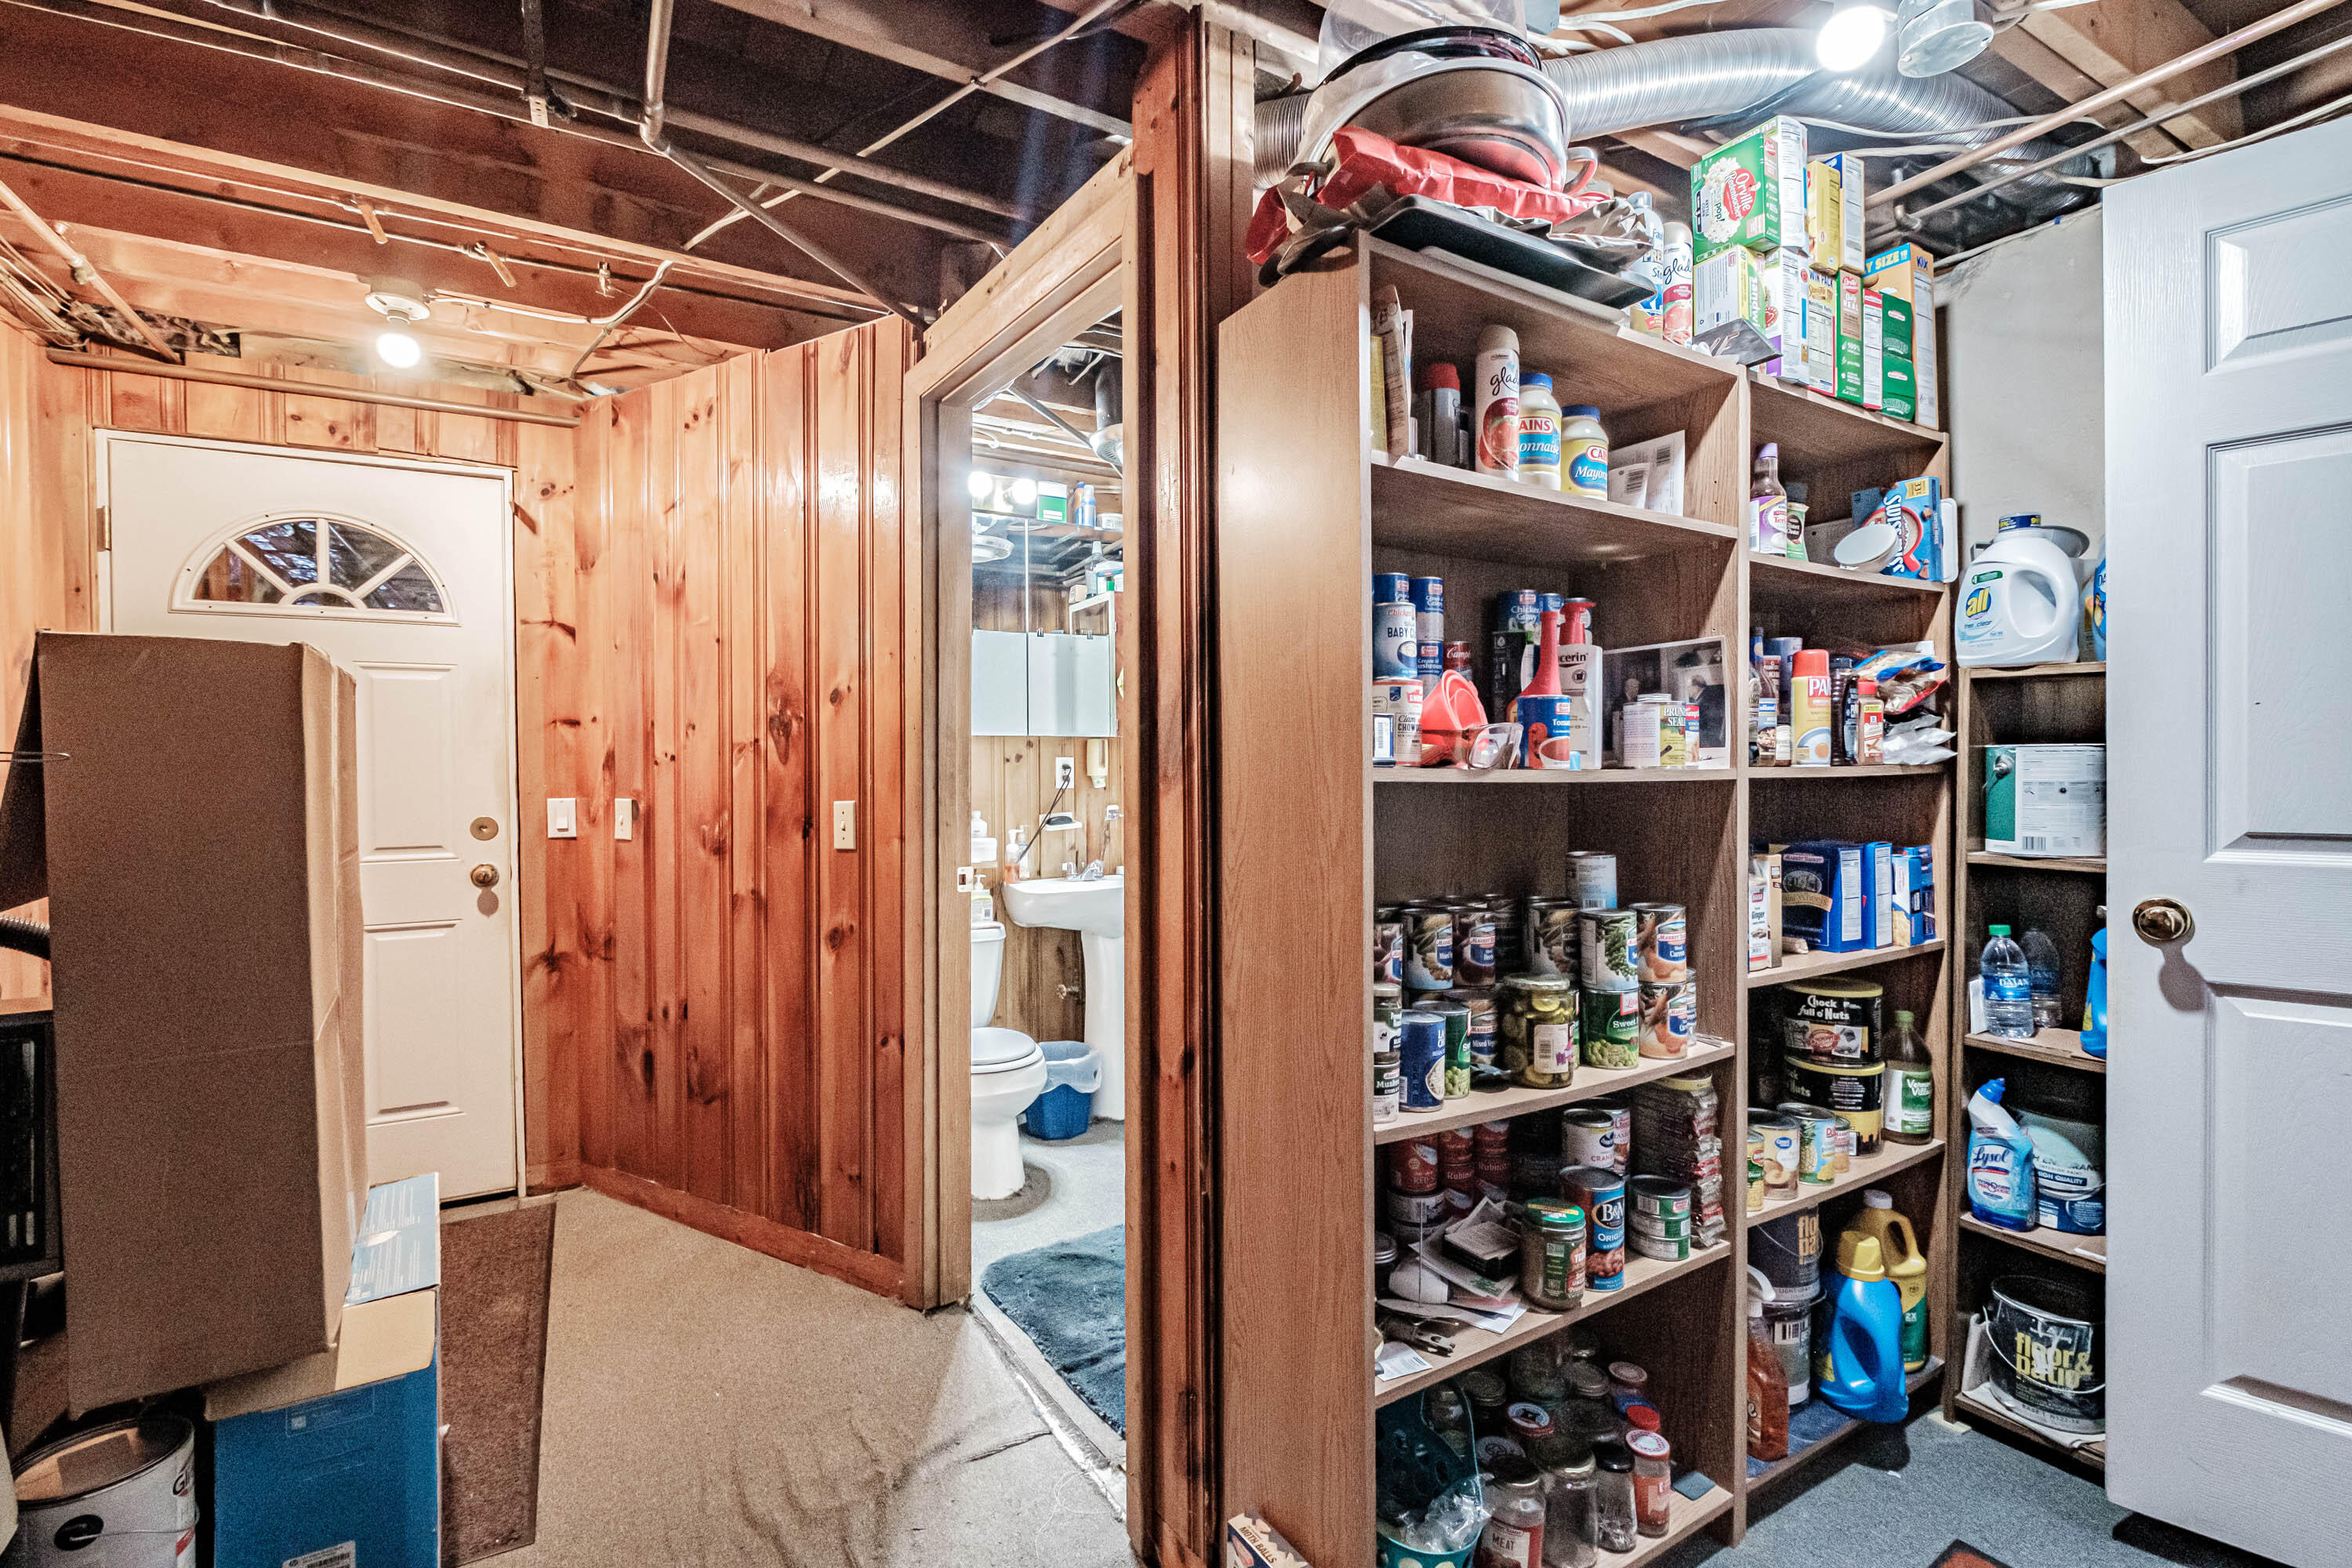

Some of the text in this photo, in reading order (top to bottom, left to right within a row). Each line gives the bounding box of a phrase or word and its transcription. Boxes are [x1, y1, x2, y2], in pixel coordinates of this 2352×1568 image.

[1735, 172, 1754, 212] Orville
[1714, 201, 1726, 223] pop!
[1875, 251, 1900, 270] SIZE
[1843, 300, 1859, 313] REAL
[1965, 587, 1991, 618] all
[1387, 627, 1409, 638] BABY
[1398, 713, 1417, 723] Clam
[1807, 995, 1837, 1008] Chock
[1797, 1004, 1816, 1016] full
[1824, 1008, 1850, 1021] Nuts
[1613, 1020, 1636, 1029] Sweet
[1472, 1039, 1487, 1047] Mixed
[1973, 1149, 2009, 1167] Lysol
[2055, 1175, 2083, 1185] QUALITY
[1905, 1312, 1918, 1323] 2X
[2074, 1352, 2093, 1377] &
[1239, 1526, 1278, 1563] MOTH BALLS
[1492, 1533, 1515, 1551] MEAT
